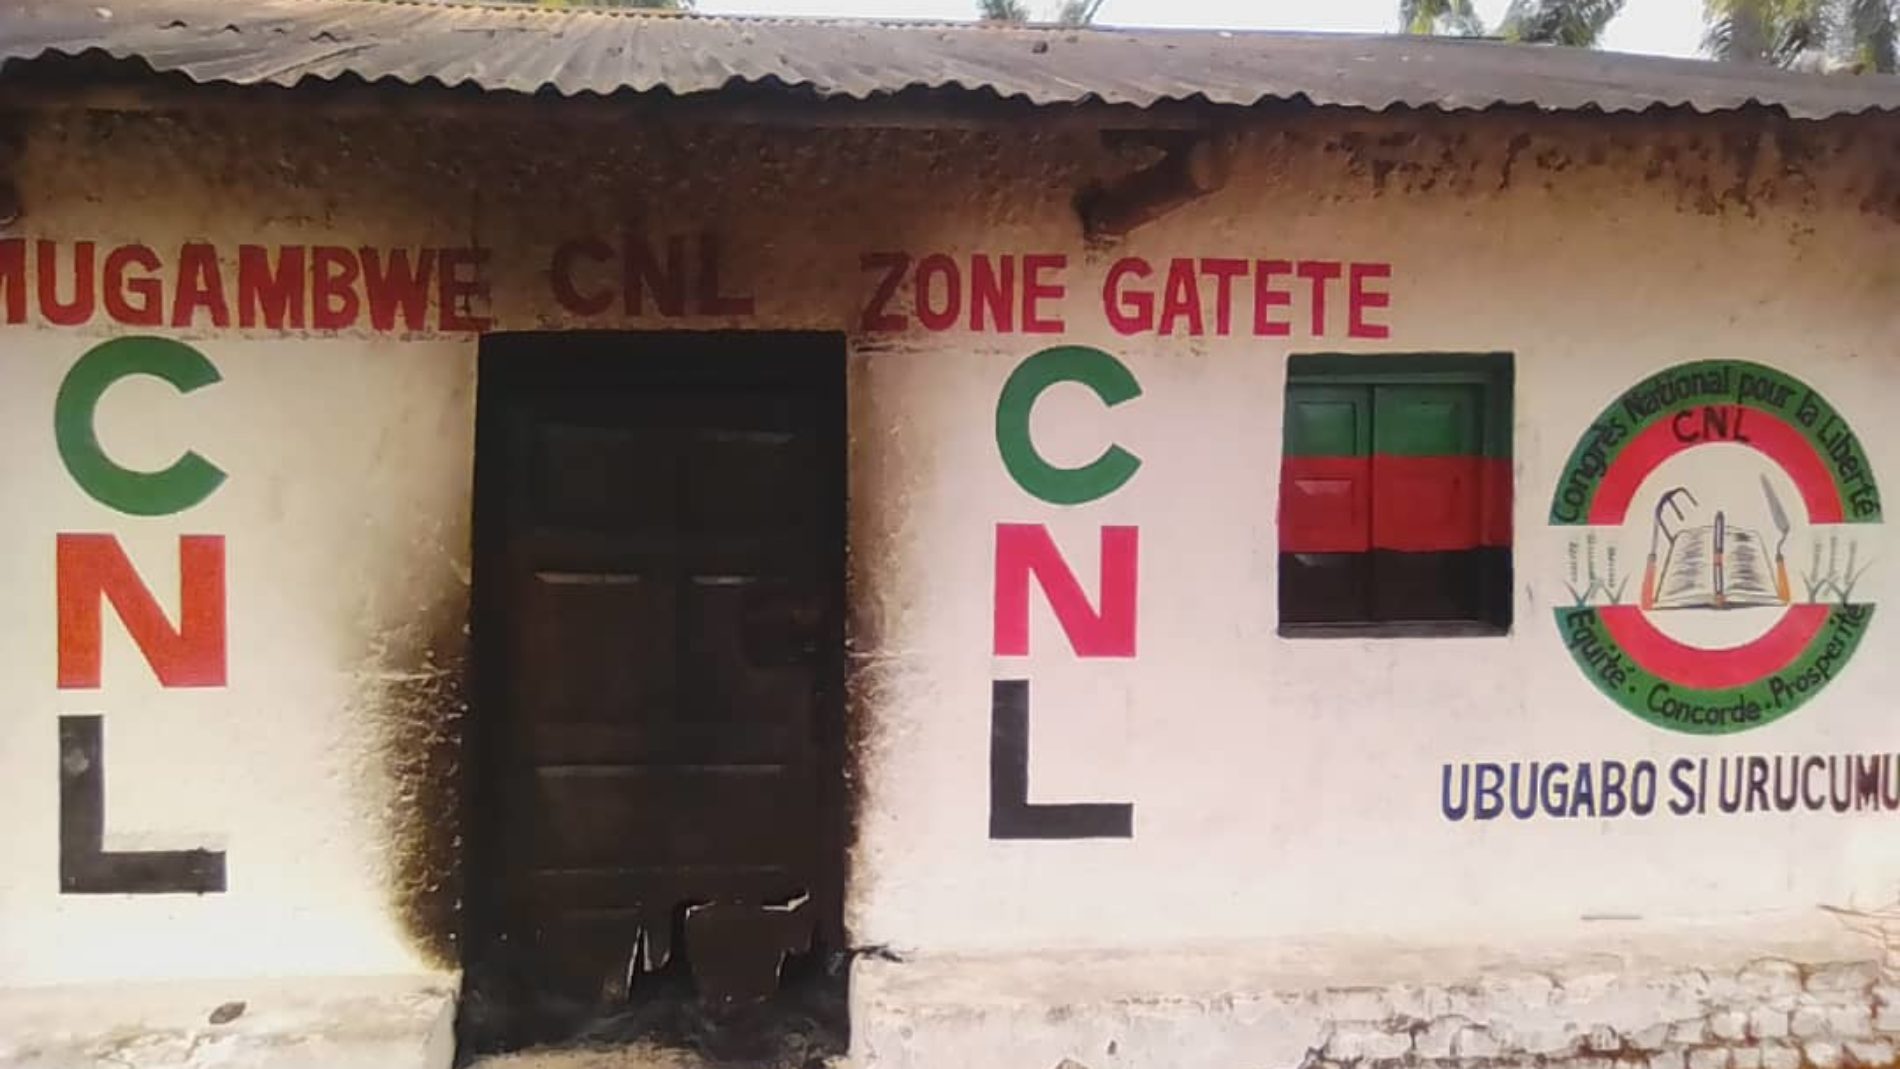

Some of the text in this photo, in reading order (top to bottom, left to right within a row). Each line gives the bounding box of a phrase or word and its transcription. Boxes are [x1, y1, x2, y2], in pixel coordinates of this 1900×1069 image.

[550, 233, 755, 318] CNL
[860, 252, 1068, 333] ZONE
[1102, 256, 1391, 338] GATETE
[1622, 366, 1730, 424] National
[1736, 372, 1796, 408] pour
[1796, 389, 1818, 428] la
[1817, 413, 1881, 518] Liberté
[1672, 405, 1750, 443] CNL
[54, 335, 228, 895] CNL
[989, 345, 1143, 839] CNL
[1647, 682, 1761, 725] Concorde
[1441, 760, 1657, 821] UBUGABO
[1668, 757, 1708, 816] SI
